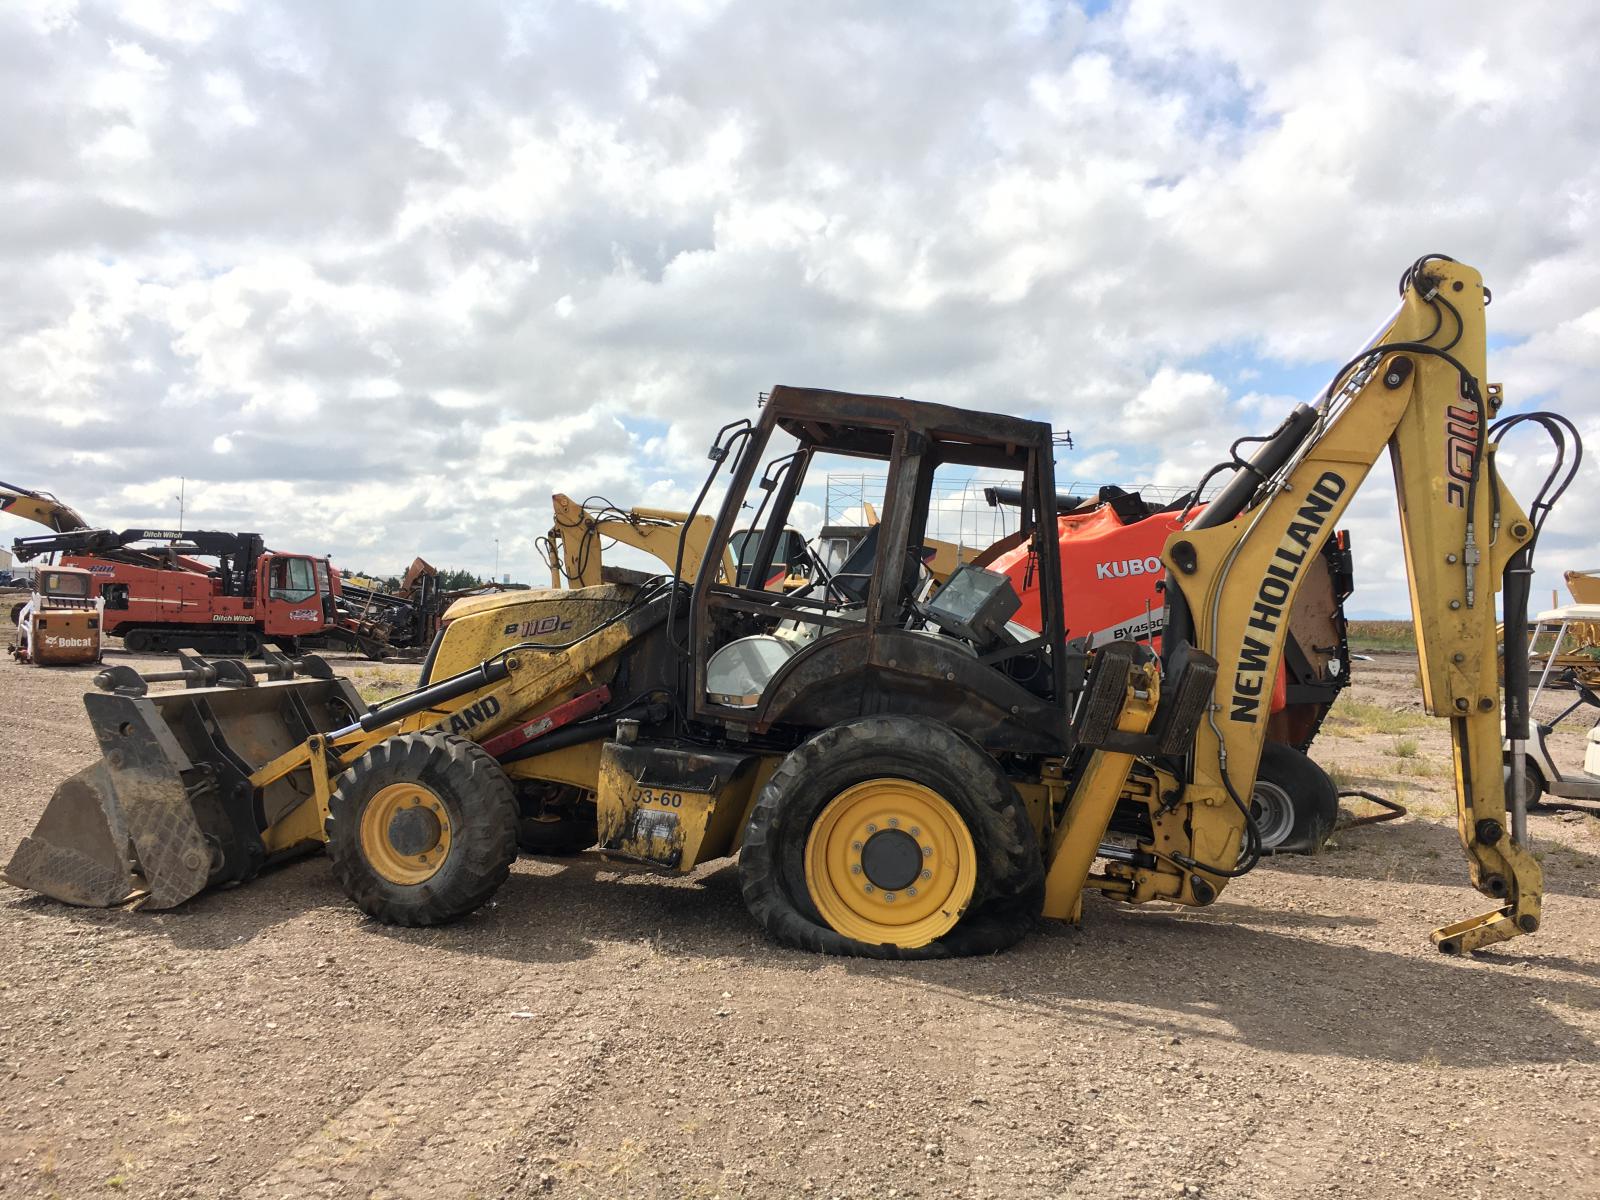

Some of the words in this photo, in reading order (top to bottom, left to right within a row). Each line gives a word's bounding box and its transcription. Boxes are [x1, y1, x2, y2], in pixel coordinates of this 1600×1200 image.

[1248, 471, 1346, 633] HOLLAND
[58, 637, 91, 648] Bobcat
[213, 614, 232, 622] Ditch
[1230, 635, 1270, 723] NEW
